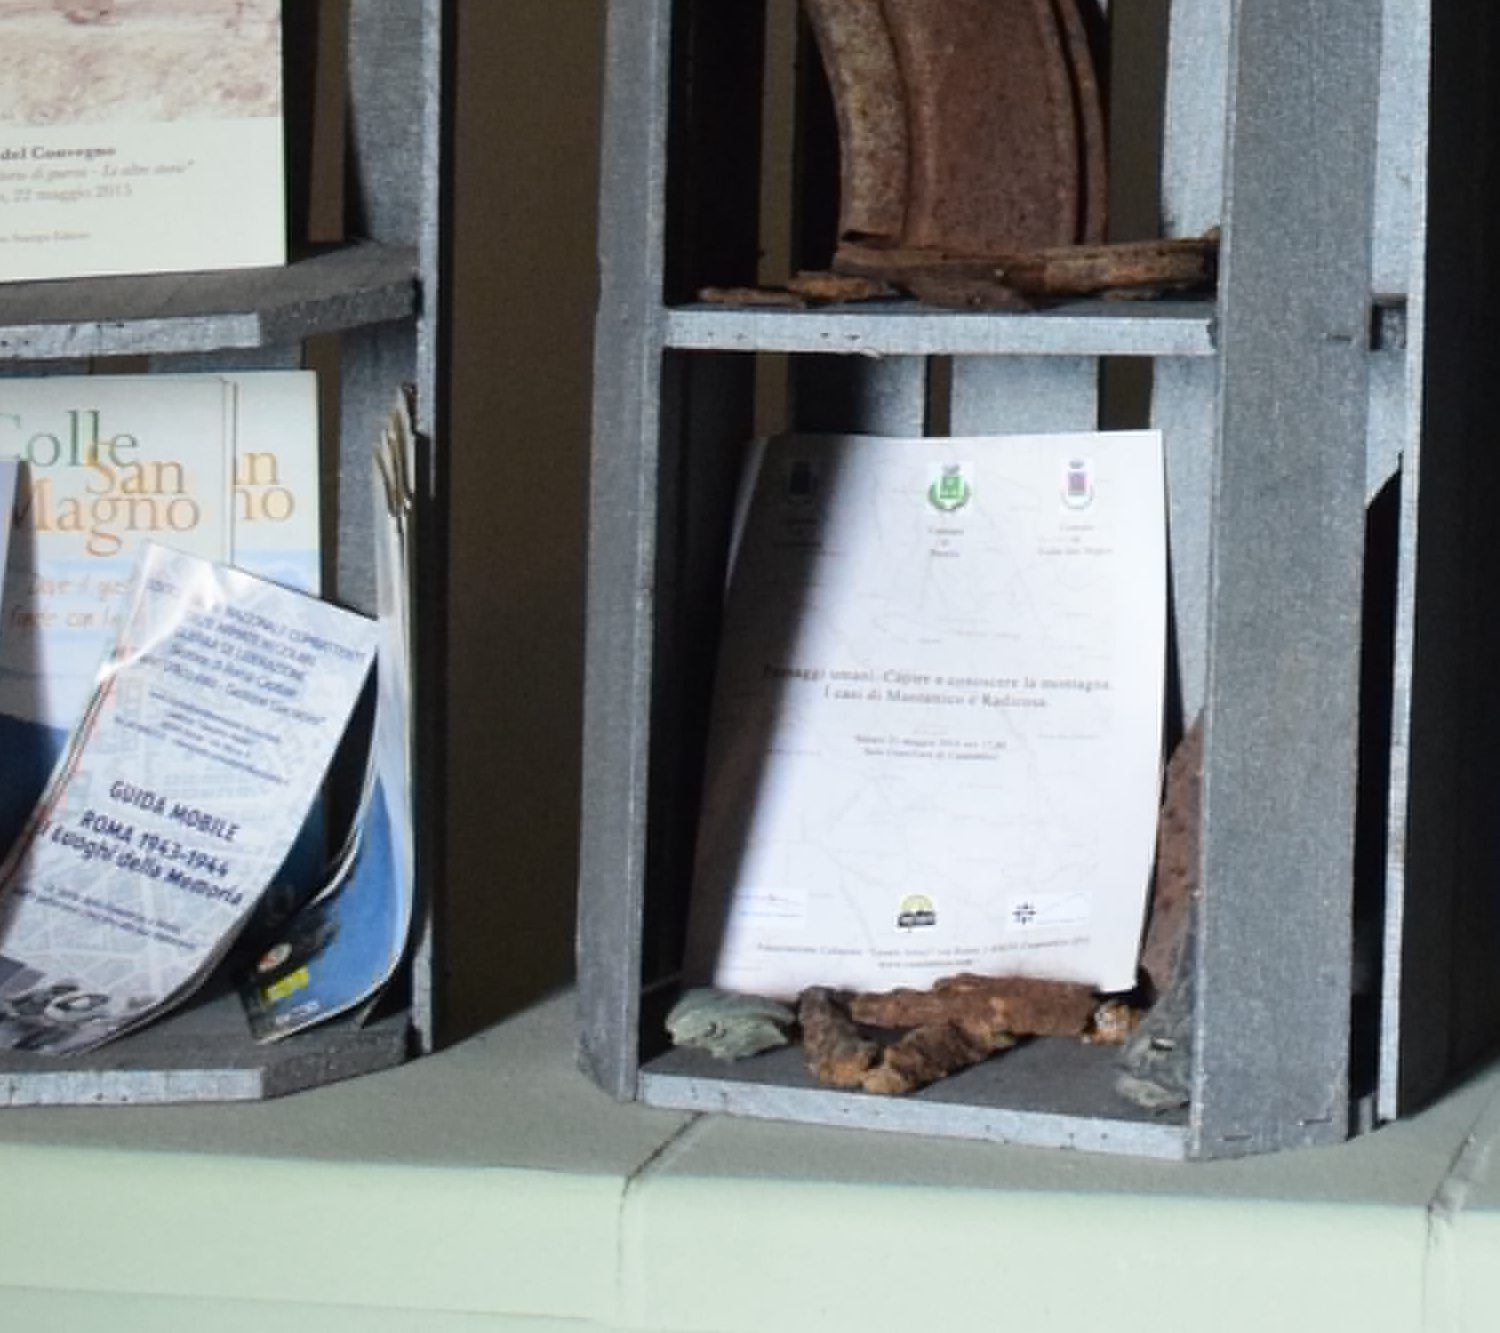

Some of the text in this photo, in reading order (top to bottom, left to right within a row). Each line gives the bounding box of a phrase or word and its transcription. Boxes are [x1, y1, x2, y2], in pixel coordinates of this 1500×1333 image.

[0, 146, 27, 161] del
[31, 144, 117, 162] Convegno
[84, 445, 184, 494] San
[867, 688, 883, 701] di
[947, 676, 1017, 689] conoscere
[109, 779, 241, 843] GUIDA MOBILE
[80, 809, 229, 878] ROMA 1943-1944
[115, 851, 162, 879] della
[163, 867, 244, 906] Memoria
